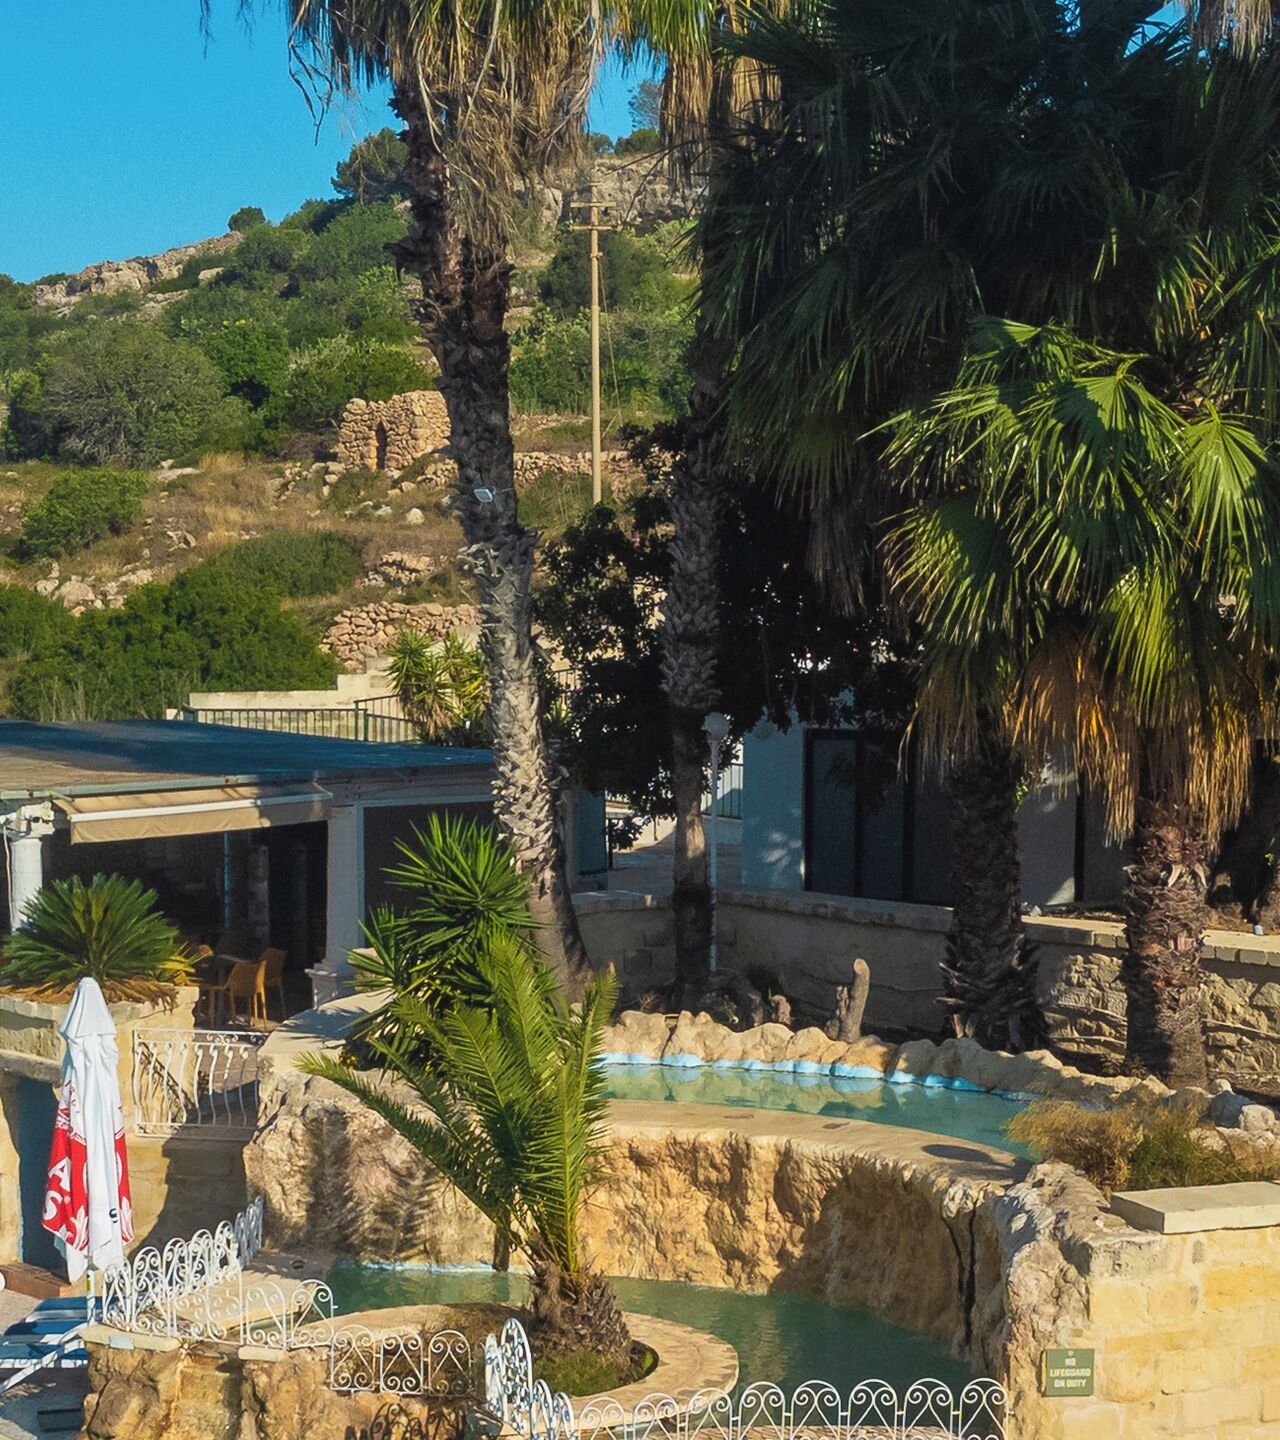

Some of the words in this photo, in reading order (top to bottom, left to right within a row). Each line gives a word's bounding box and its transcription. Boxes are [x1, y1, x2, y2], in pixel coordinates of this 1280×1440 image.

[1050, 1368, 1091, 1377] LIFEGUARD
[1054, 1379, 1065, 1388] ON
[1066, 1379, 1086, 1388] DUTY
